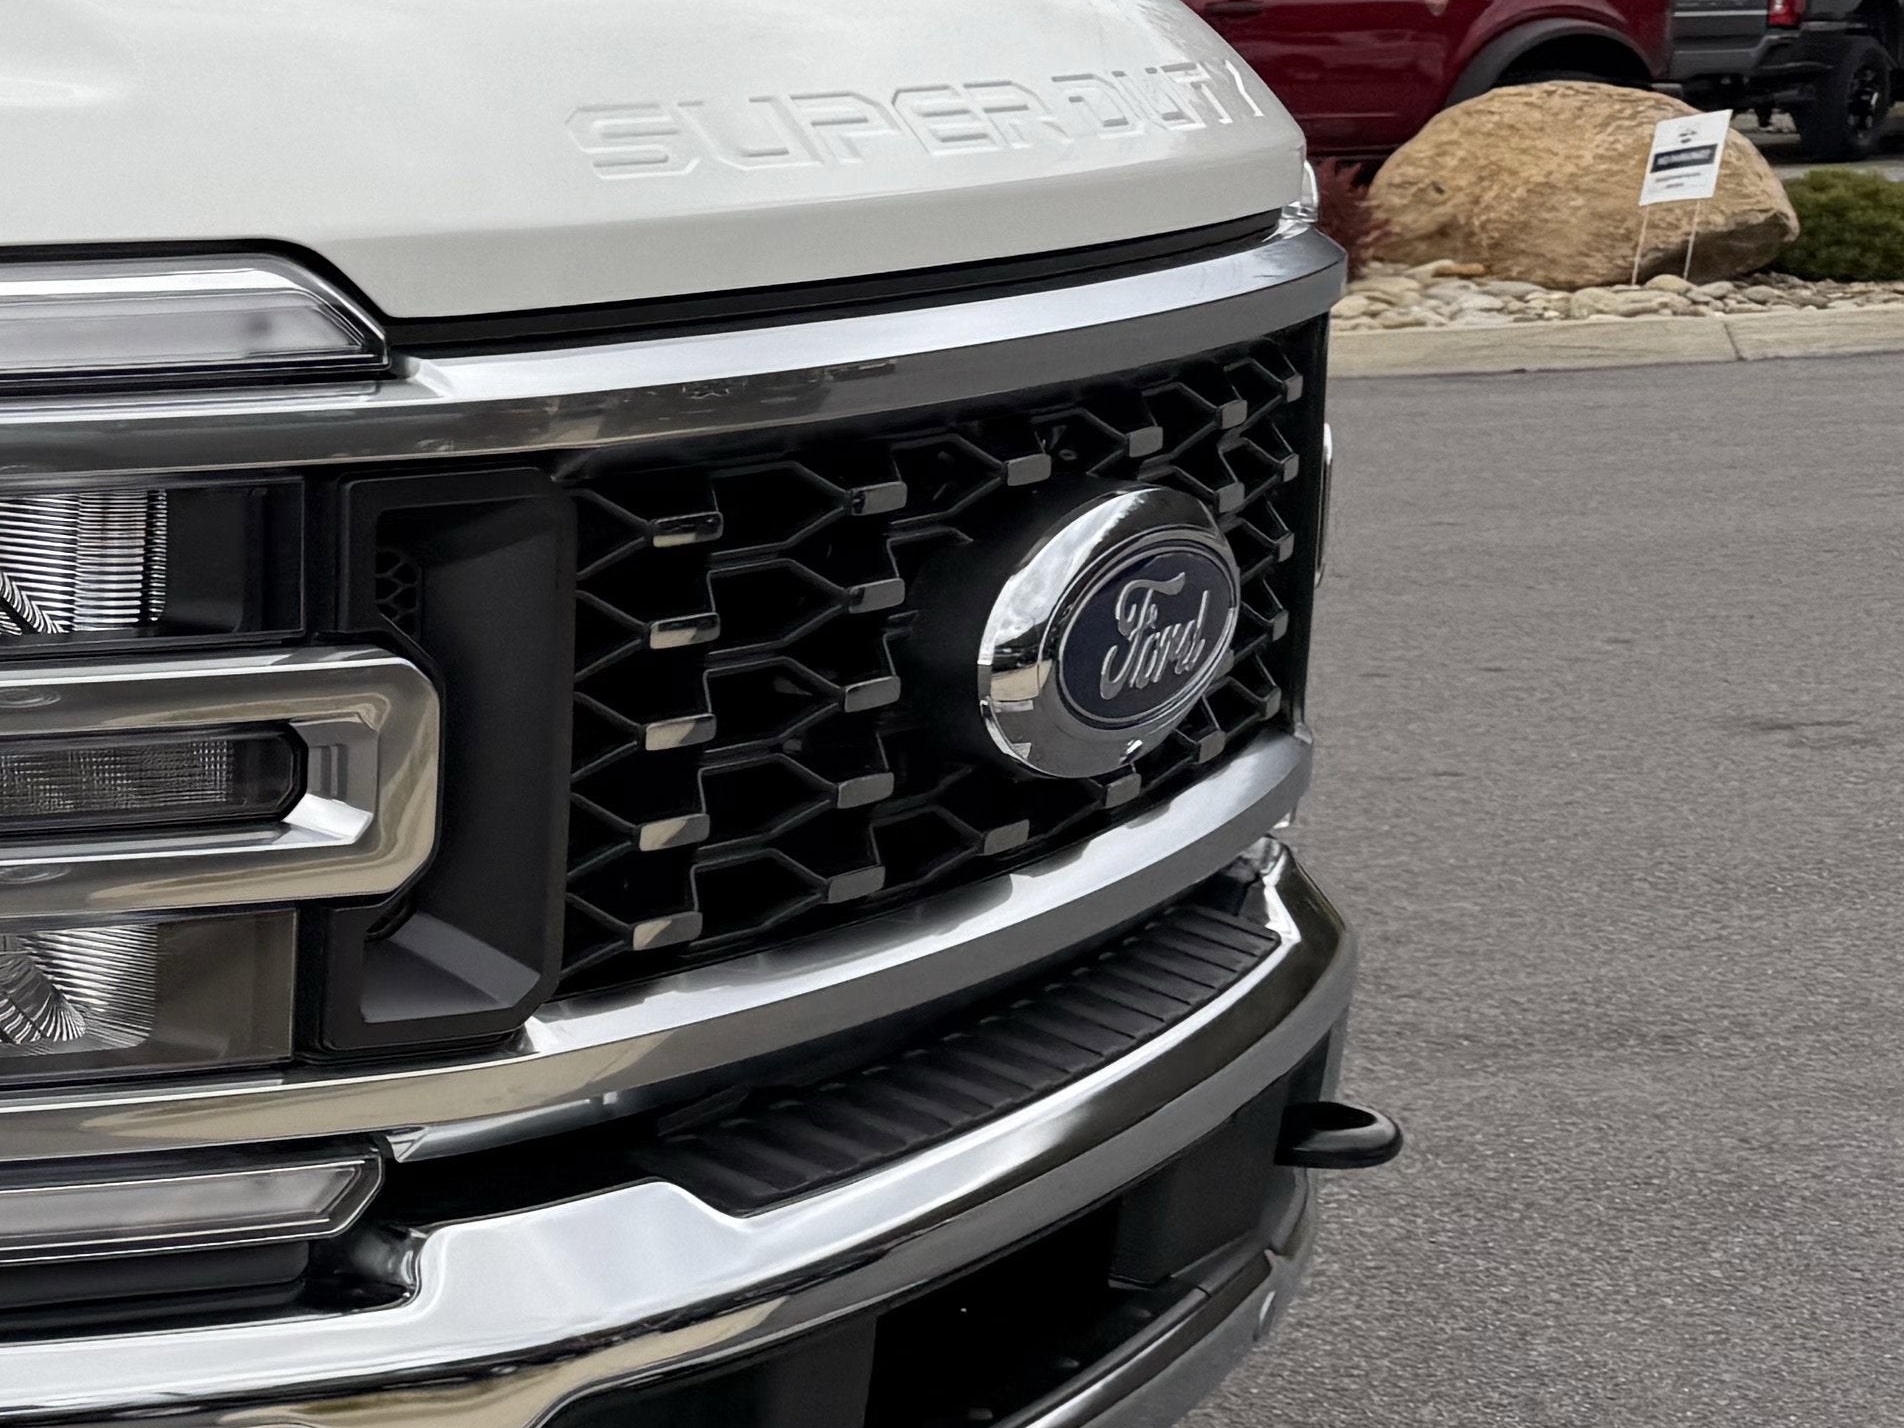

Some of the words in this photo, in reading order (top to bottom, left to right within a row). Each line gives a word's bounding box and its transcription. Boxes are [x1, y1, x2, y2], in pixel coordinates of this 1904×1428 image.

[565, 78, 1075, 180] SUPER
[1049, 60, 1265, 140] DUTY
[1099, 571, 1210, 701] Ford
